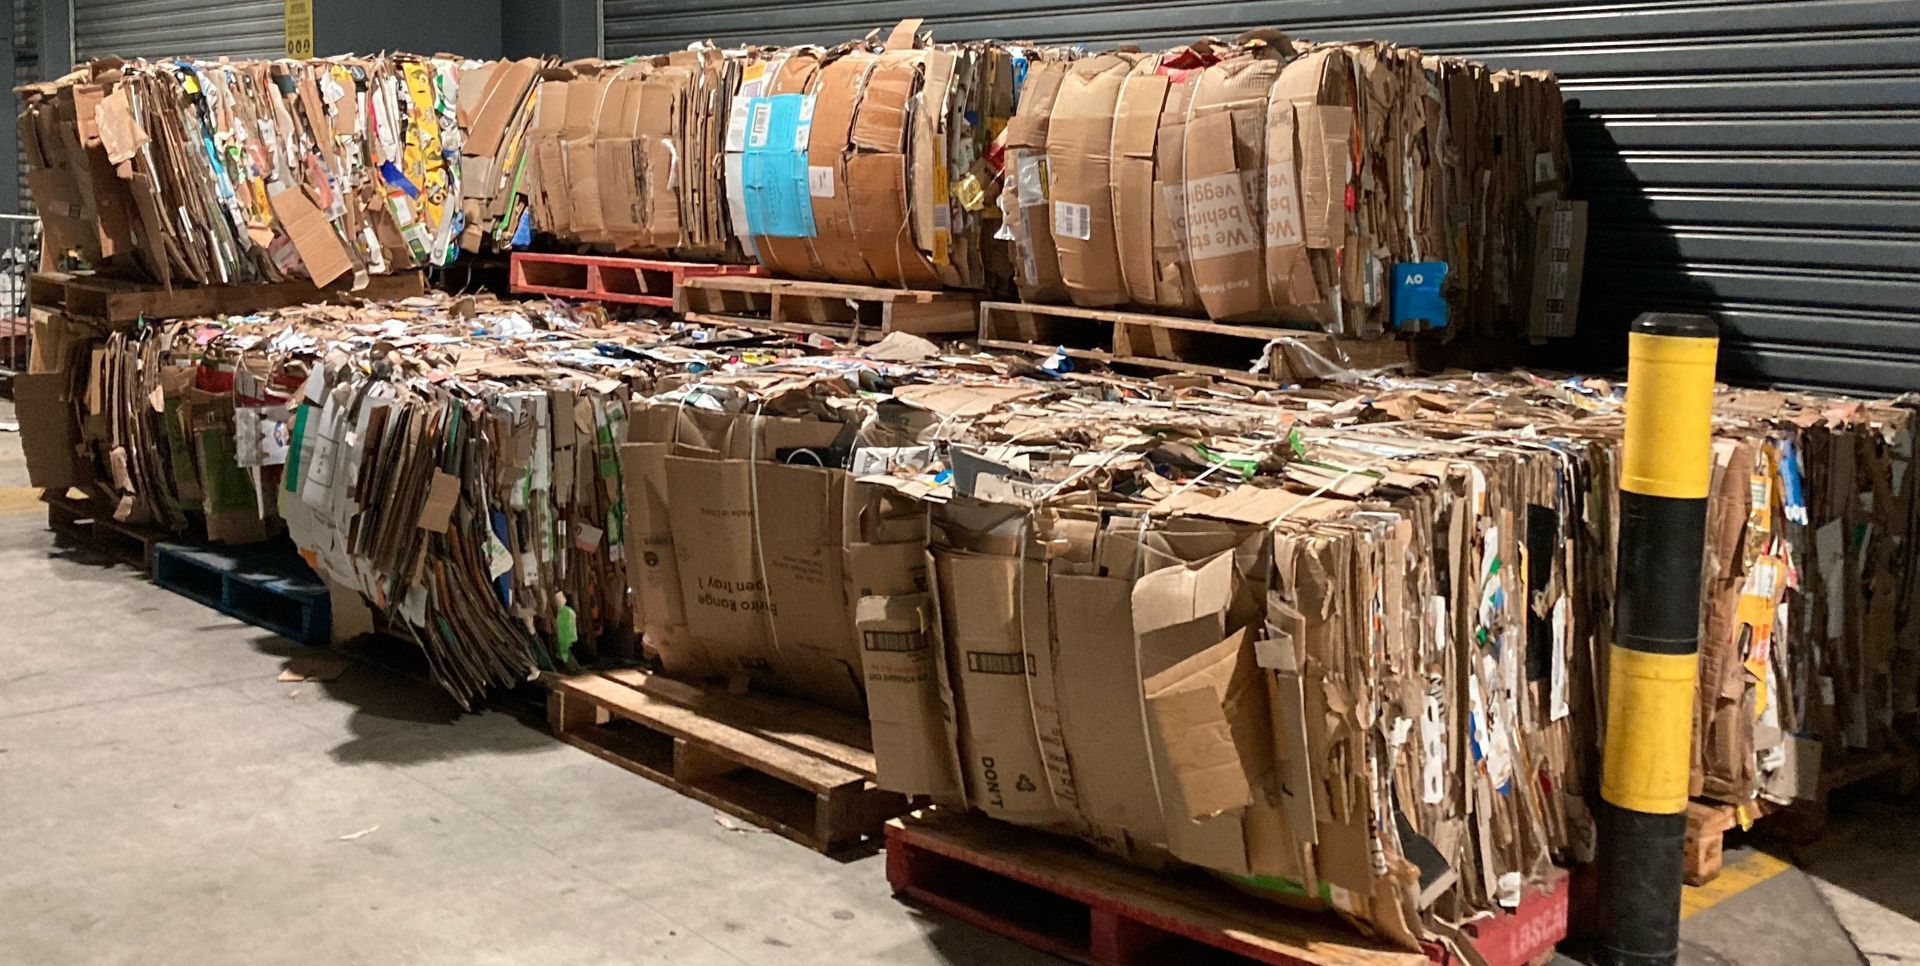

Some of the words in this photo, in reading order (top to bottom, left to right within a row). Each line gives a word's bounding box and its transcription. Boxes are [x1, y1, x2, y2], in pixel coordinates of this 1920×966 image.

[1216, 228, 1249, 248] We
[1405, 273, 1424, 285] AO
[706, 575, 733, 593] Tray
[697, 593, 737, 612] Range
[981, 756, 1004, 809] DON'T
